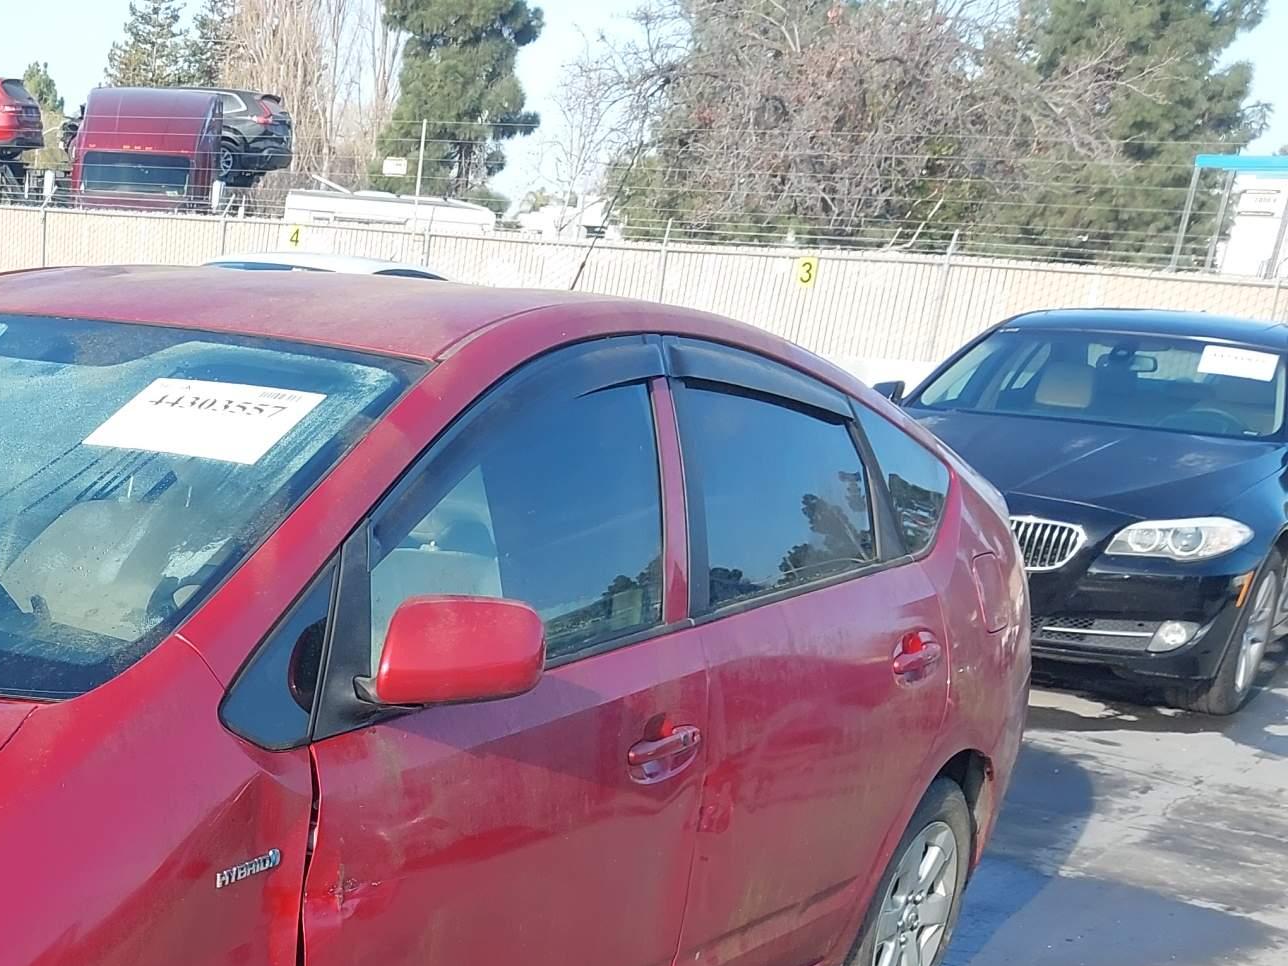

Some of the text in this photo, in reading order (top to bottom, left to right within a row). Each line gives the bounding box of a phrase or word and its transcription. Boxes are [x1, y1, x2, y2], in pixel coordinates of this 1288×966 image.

[289, 228, 300, 247] 4
[800, 261, 813, 283] 3
[149, 394, 289, 418] 44303557
[215, 853, 274, 889] HYBRID
